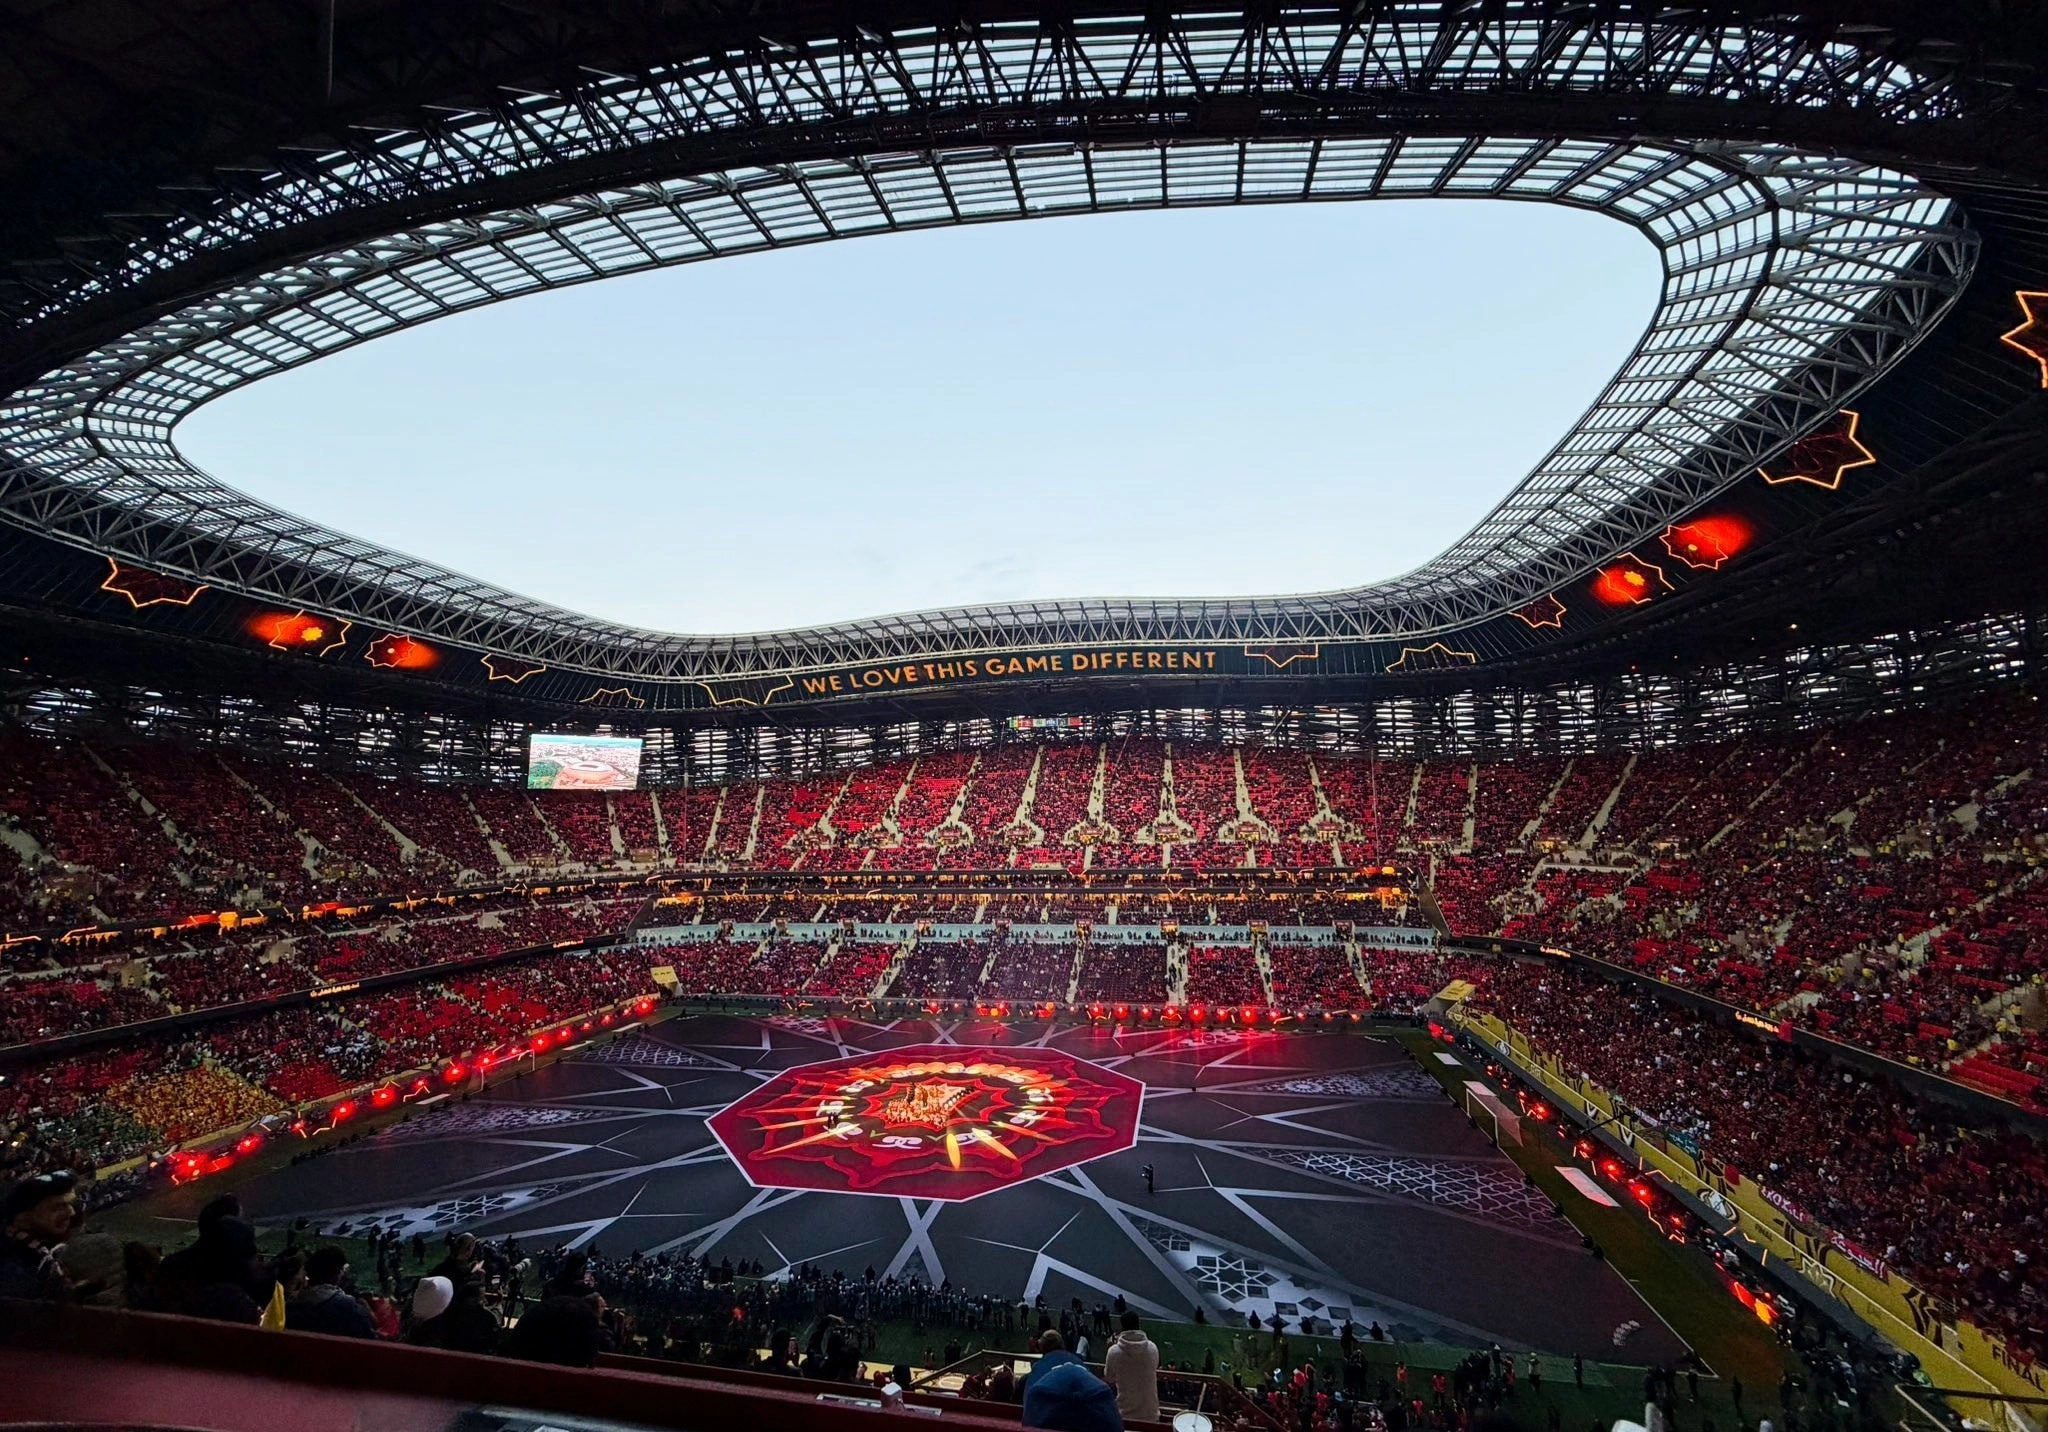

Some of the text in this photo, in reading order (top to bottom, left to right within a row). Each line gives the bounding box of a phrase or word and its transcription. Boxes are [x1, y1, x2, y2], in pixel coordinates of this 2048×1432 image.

[803, 651, 1216, 694] WE LOVE THIS GAME DIFFERENT
[1992, 1344, 2045, 1392] FINAL
